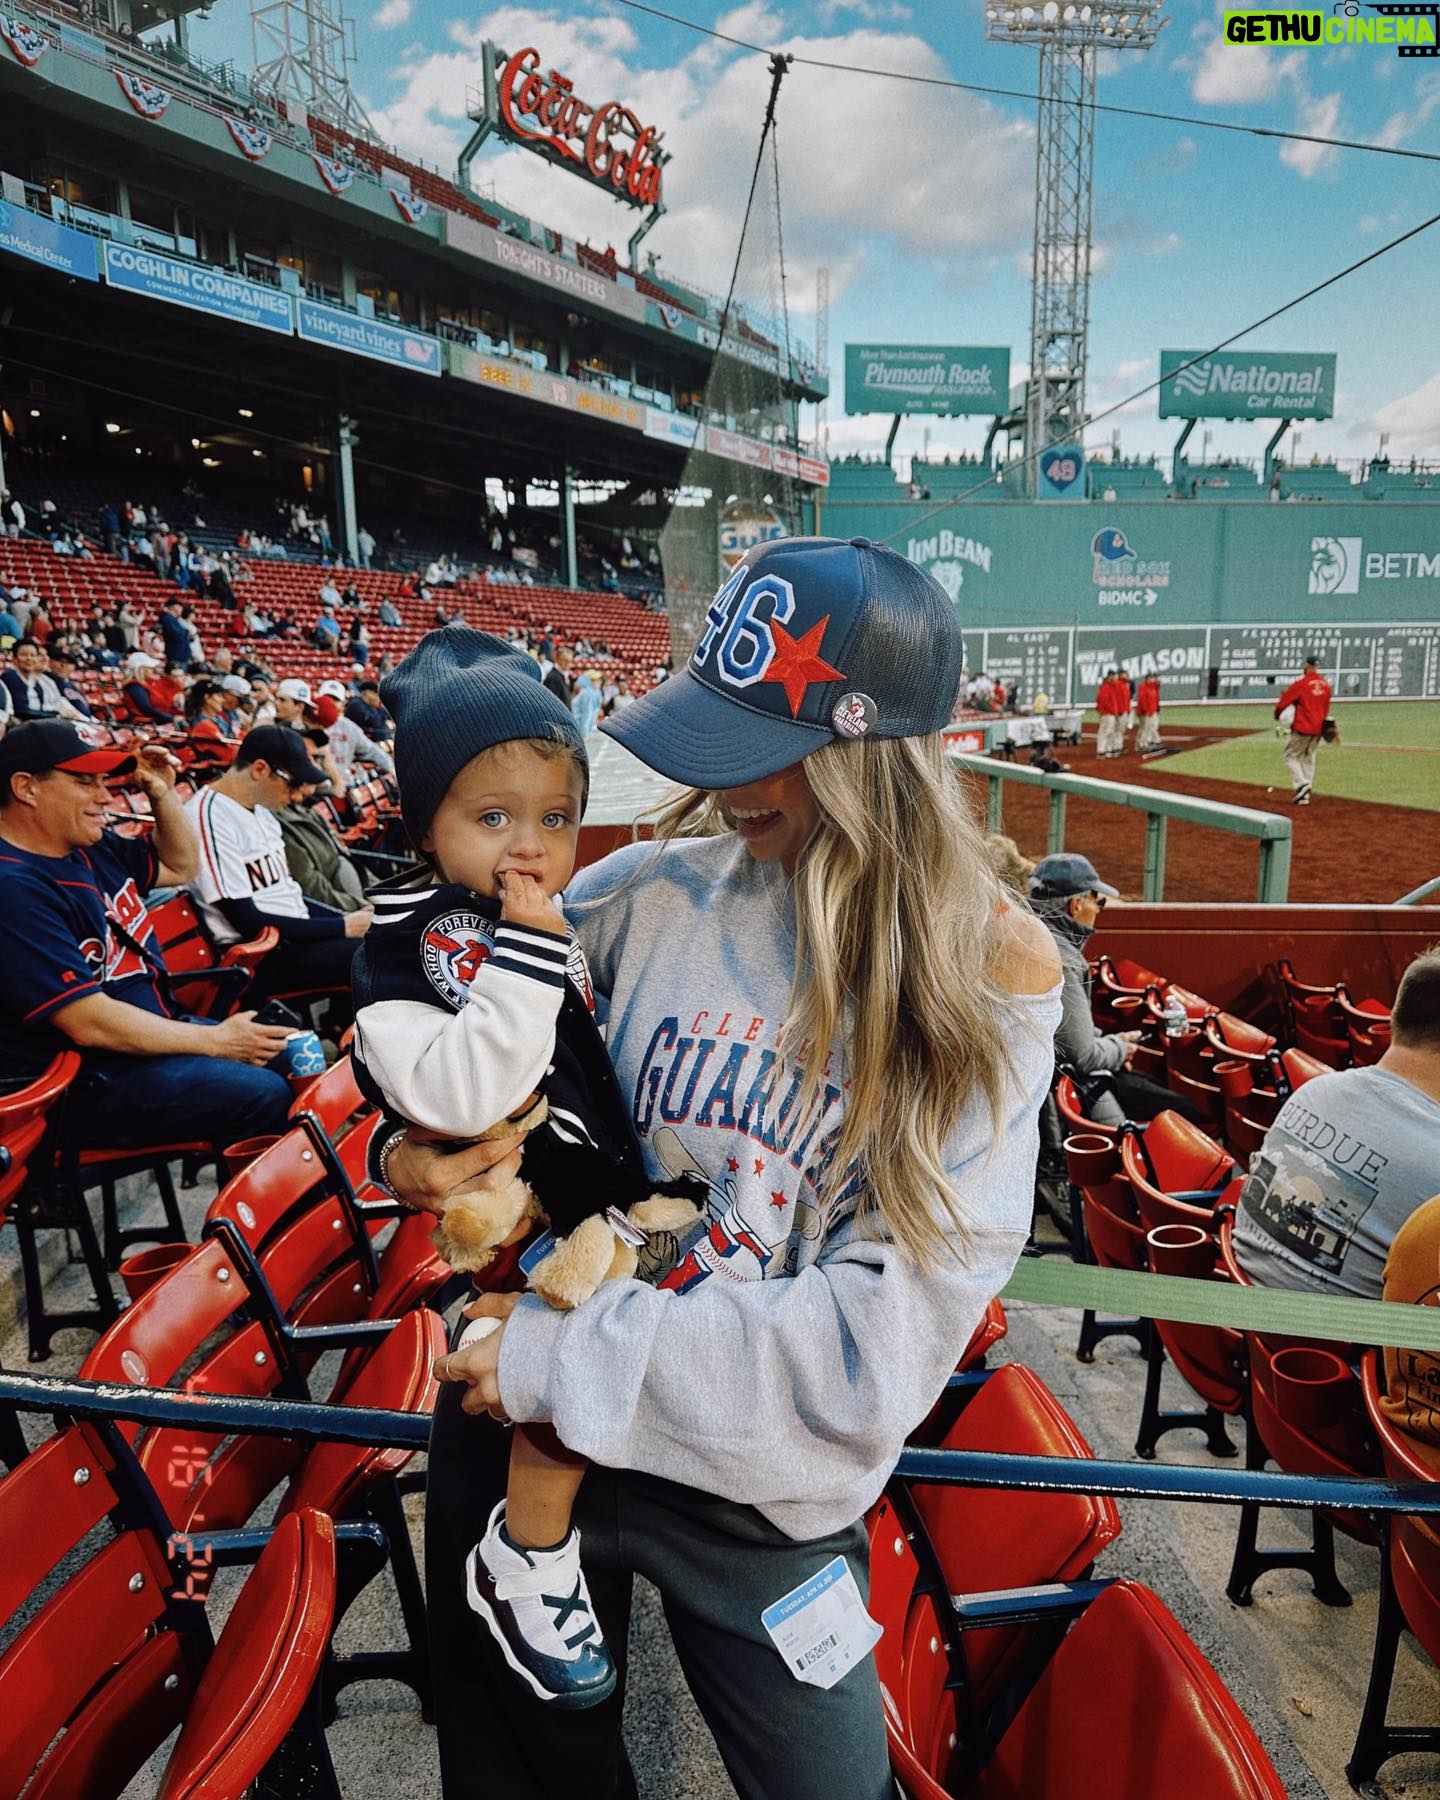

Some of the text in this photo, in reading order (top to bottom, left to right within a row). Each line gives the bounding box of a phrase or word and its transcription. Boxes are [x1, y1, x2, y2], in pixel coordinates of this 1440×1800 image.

[500, 47, 662, 204] Coca-Cola
[11, 234, 43, 256] Medical
[44, 248, 72, 268] Center
[108, 249, 288, 315] COGHLIN COMPANIES
[304, 312, 366, 341] vineyard
[865, 363, 992, 386] Plymouth Rock
[1247, 395, 1316, 408] Car Rental
[907, 530, 992, 573] JIM BEAM
[1098, 590, 1142, 605] BIDMC
[1122, 647, 1204, 679] MASON
[437, 915, 496, 936] FOREVER
[426, 944, 451, 993] WAHOO
[1282, 1101, 1389, 1186] PURDUE
